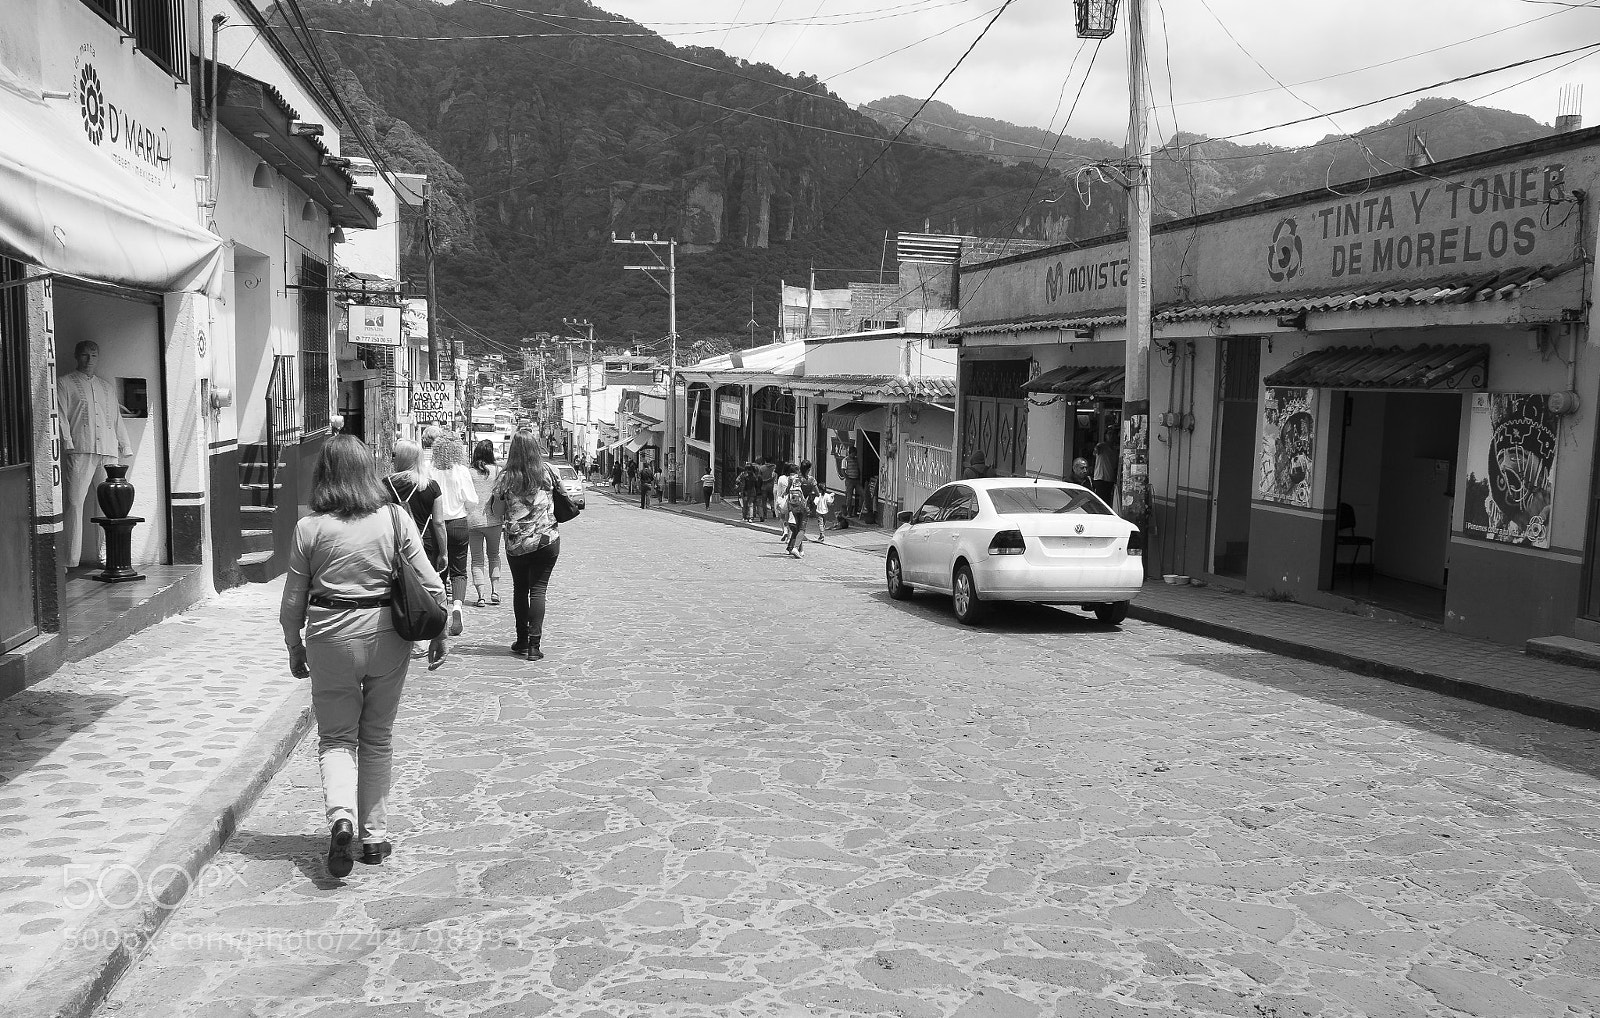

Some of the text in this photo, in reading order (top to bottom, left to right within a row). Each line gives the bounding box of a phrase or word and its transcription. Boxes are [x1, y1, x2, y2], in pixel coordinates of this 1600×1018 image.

[1318, 163, 1566, 240] TINTA Y TONER
[1331, 216, 1538, 278] DE MORELOS
[1067, 258, 1128, 295] movista
[413, 392, 450, 402] CASA CON
[419, 381, 446, 392] VENDO
[413, 401, 444, 411] ALBERCA
